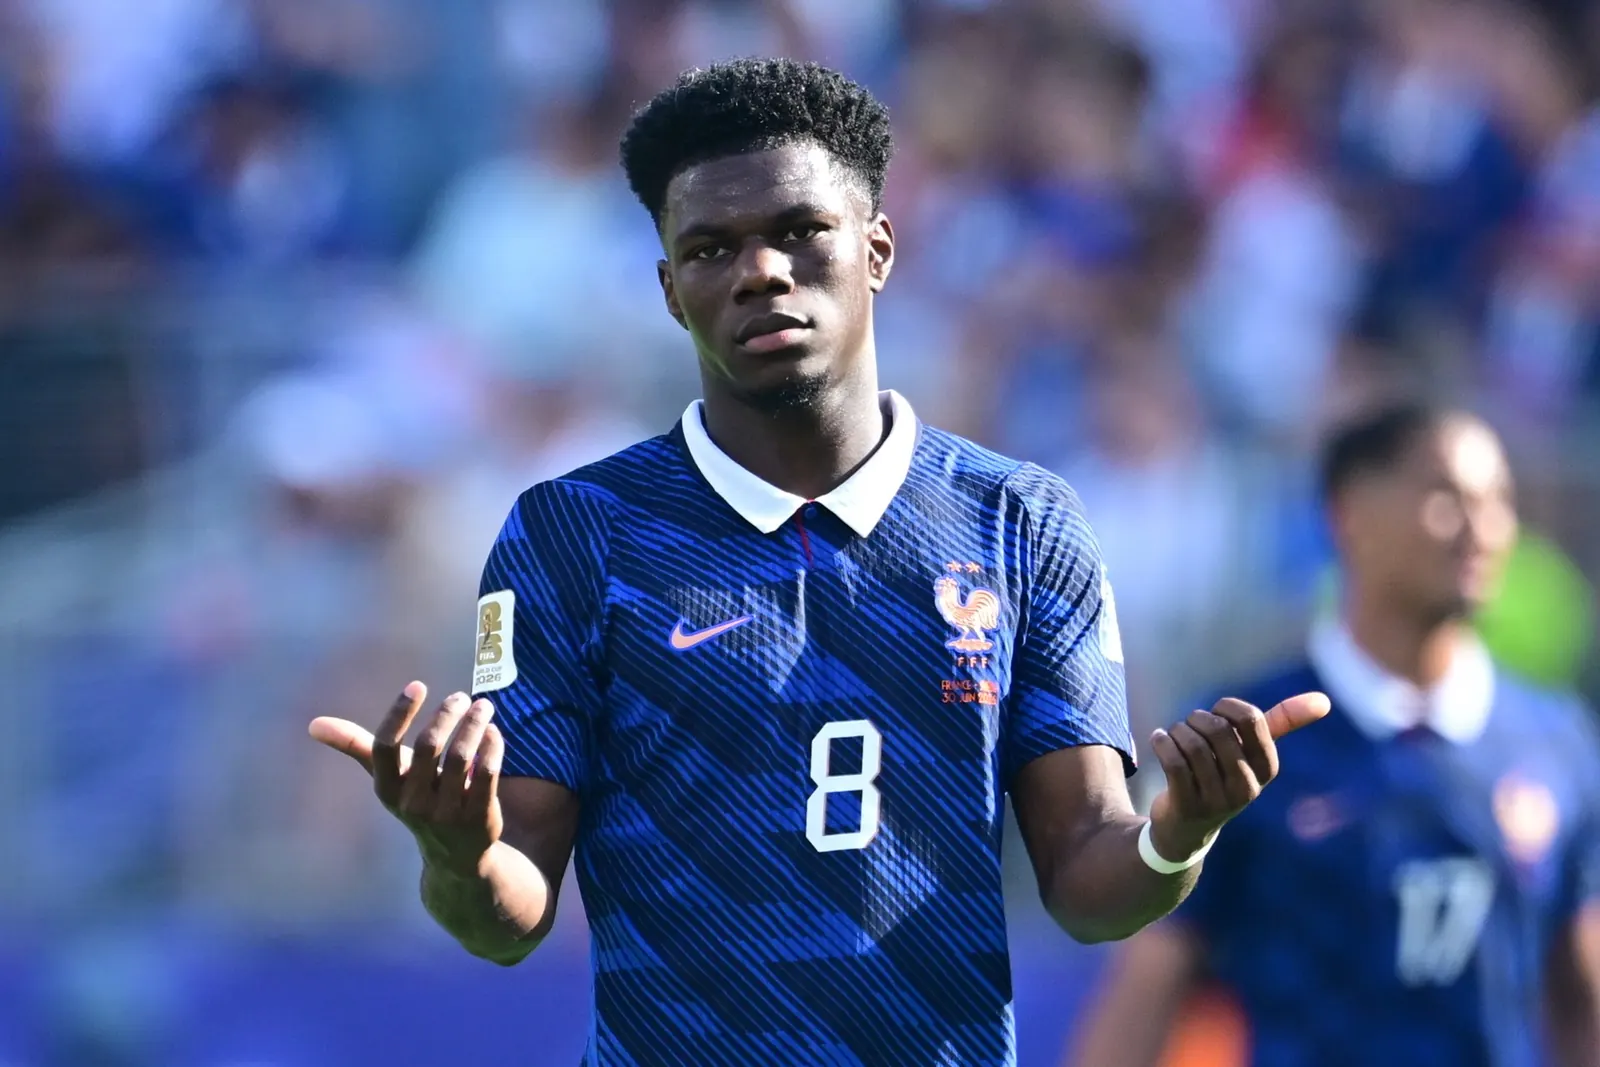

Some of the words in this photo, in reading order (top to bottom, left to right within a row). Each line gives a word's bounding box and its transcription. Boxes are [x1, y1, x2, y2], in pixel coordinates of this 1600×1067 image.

[479, 651, 496, 661] FIFA
[475, 673, 502, 686] 2026
[942, 692, 956, 703] 30
[805, 719, 882, 853] 8
